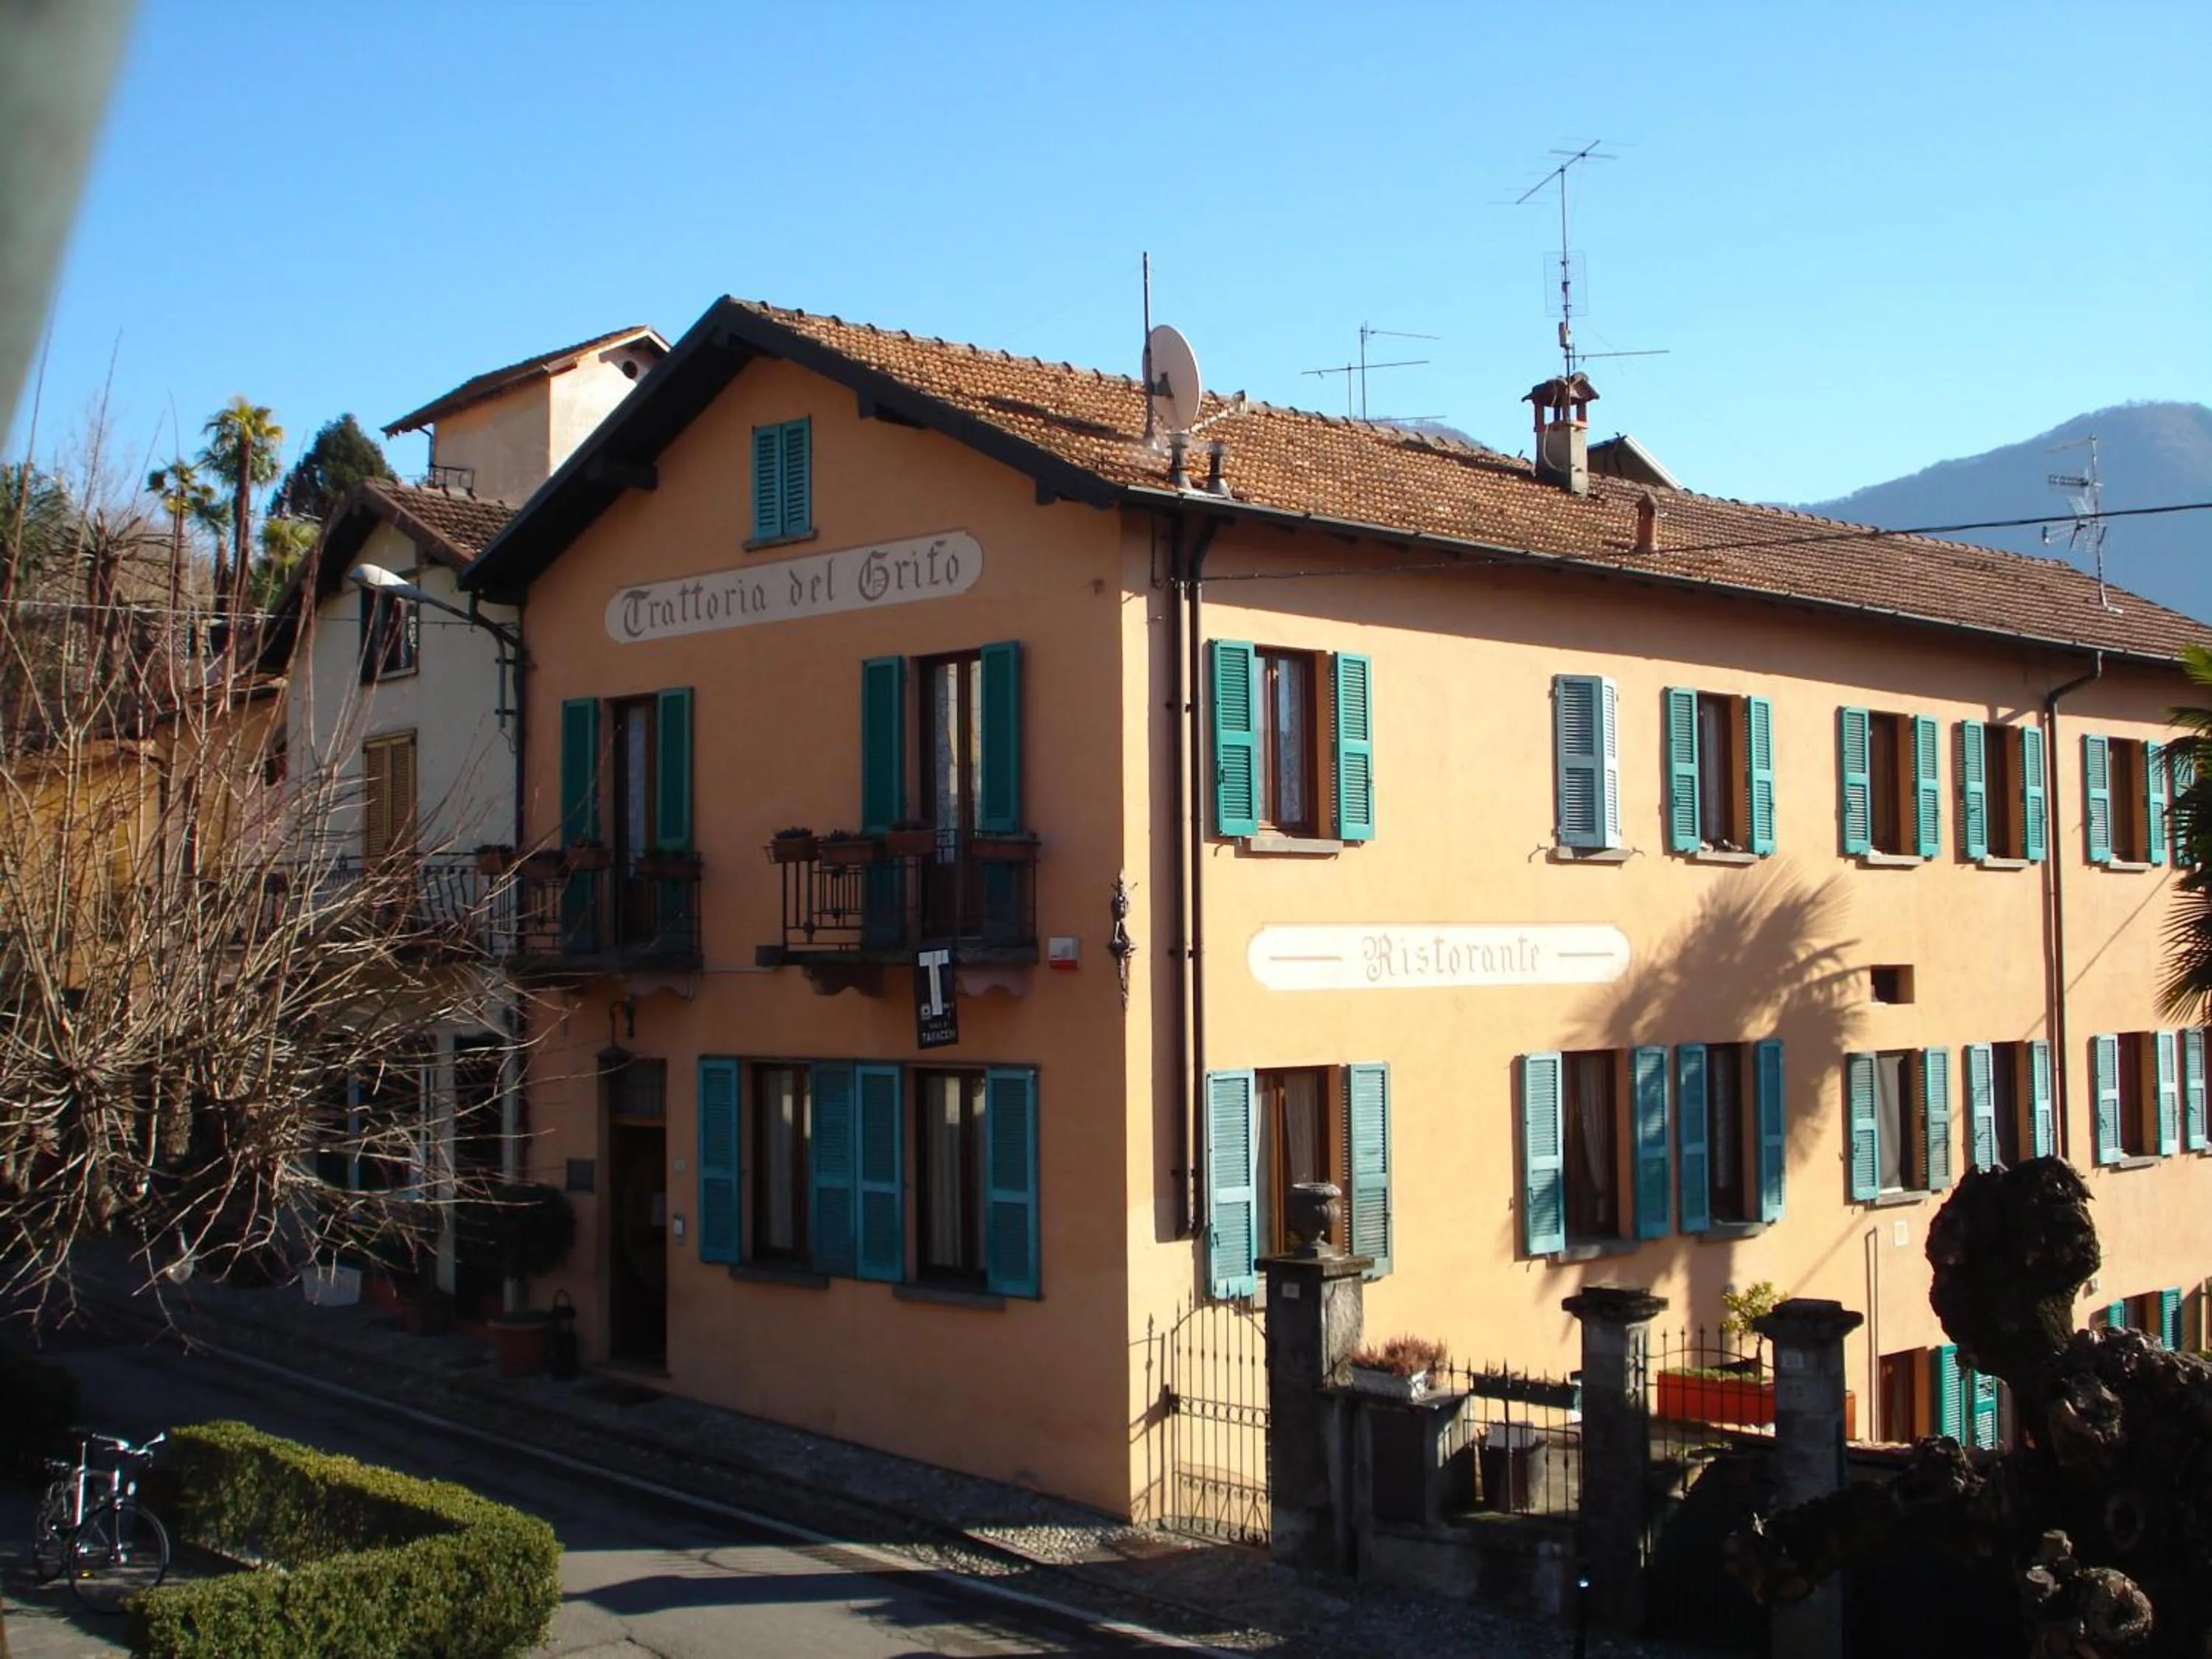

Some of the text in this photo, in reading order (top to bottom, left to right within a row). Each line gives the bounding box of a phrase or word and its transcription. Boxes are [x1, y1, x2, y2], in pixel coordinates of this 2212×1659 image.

[622, 580, 766, 637] Trattoria
[790, 557, 835, 606] del
[919, 949, 949, 1015] T
[1362, 932, 1540, 982] Ristorante
